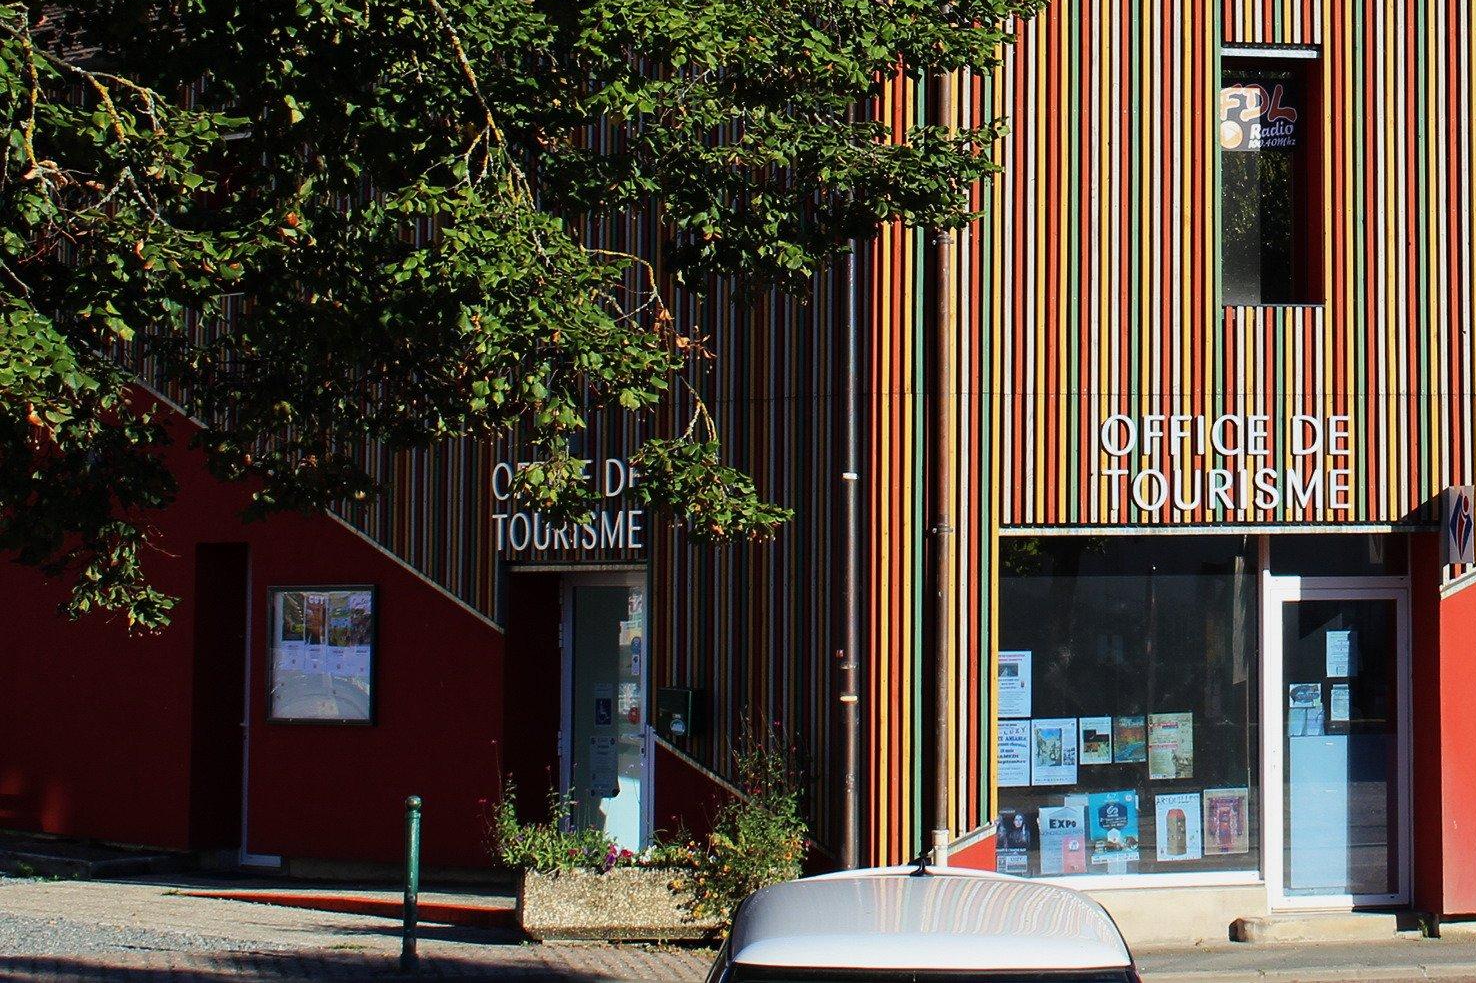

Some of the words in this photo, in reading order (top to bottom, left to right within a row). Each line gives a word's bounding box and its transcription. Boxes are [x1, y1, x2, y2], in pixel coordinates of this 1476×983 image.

[1220, 84, 1297, 122] FDL
[1250, 121, 1293, 139] Radio
[1101, 414, 1270, 456] OFFICE
[1292, 415, 1350, 455] DE
[1102, 468, 1351, 511] TOURISME
